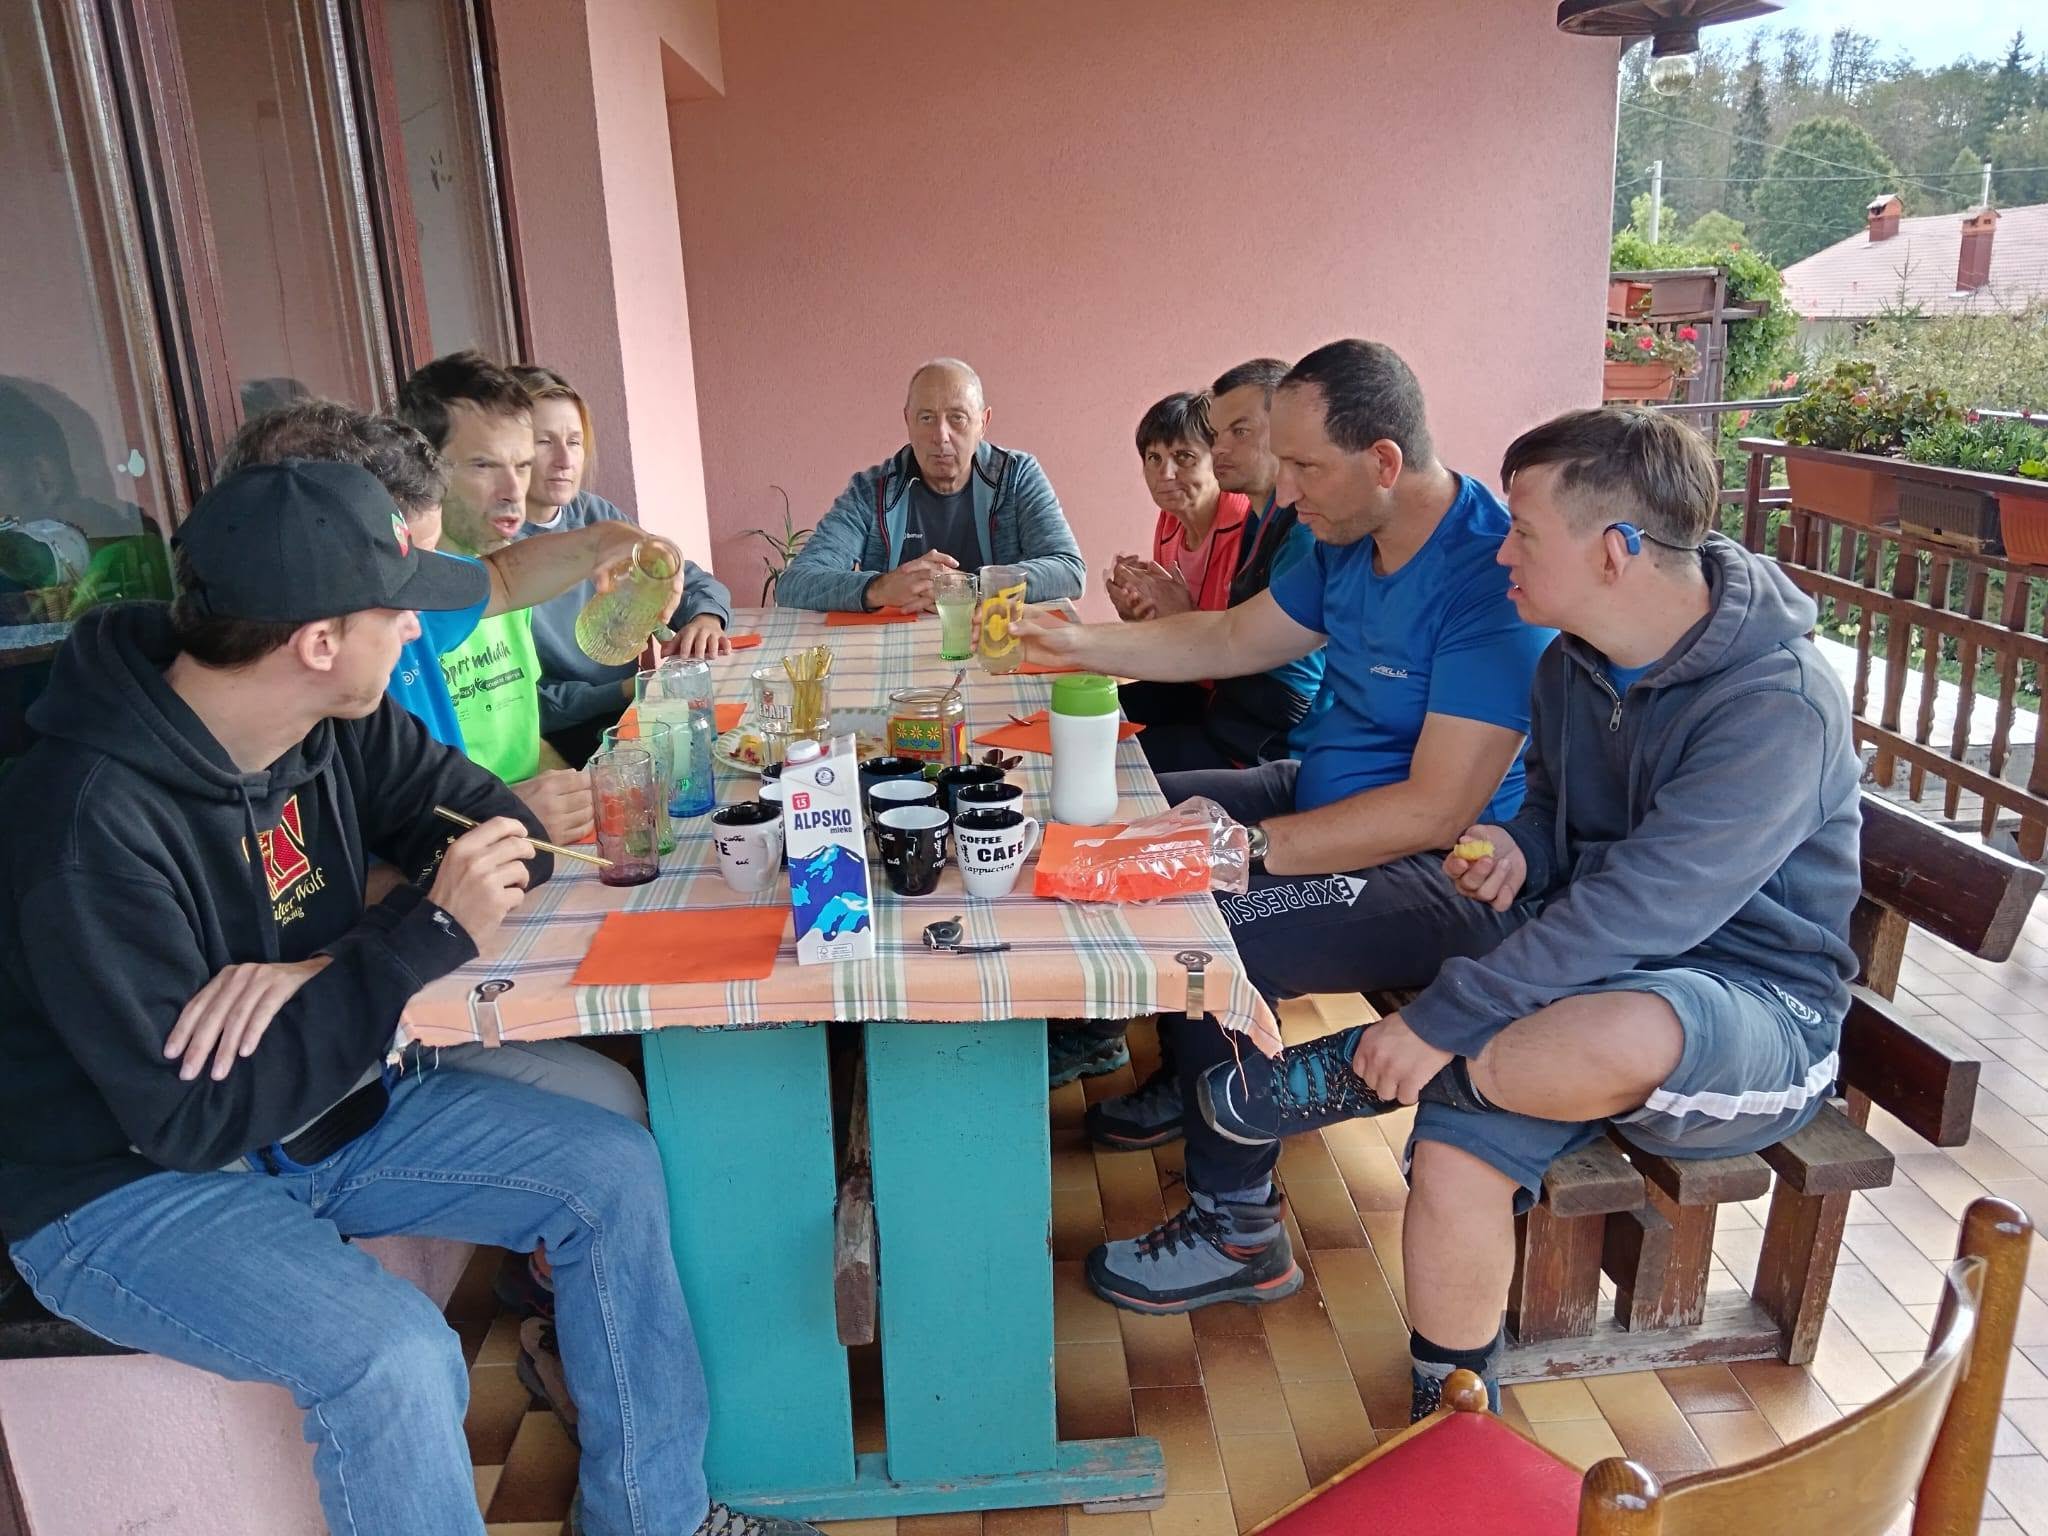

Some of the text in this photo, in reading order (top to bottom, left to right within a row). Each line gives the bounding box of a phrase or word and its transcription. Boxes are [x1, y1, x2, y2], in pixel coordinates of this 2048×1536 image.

[794, 809, 852, 830] ALPSKO
[830, 826, 853, 834] mleko
[960, 834, 1003, 844] COFFEE
[977, 840, 1024, 863] CAFE
[295, 867, 326, 902] Wolf
[1219, 877, 1356, 929] EXPRESSI
